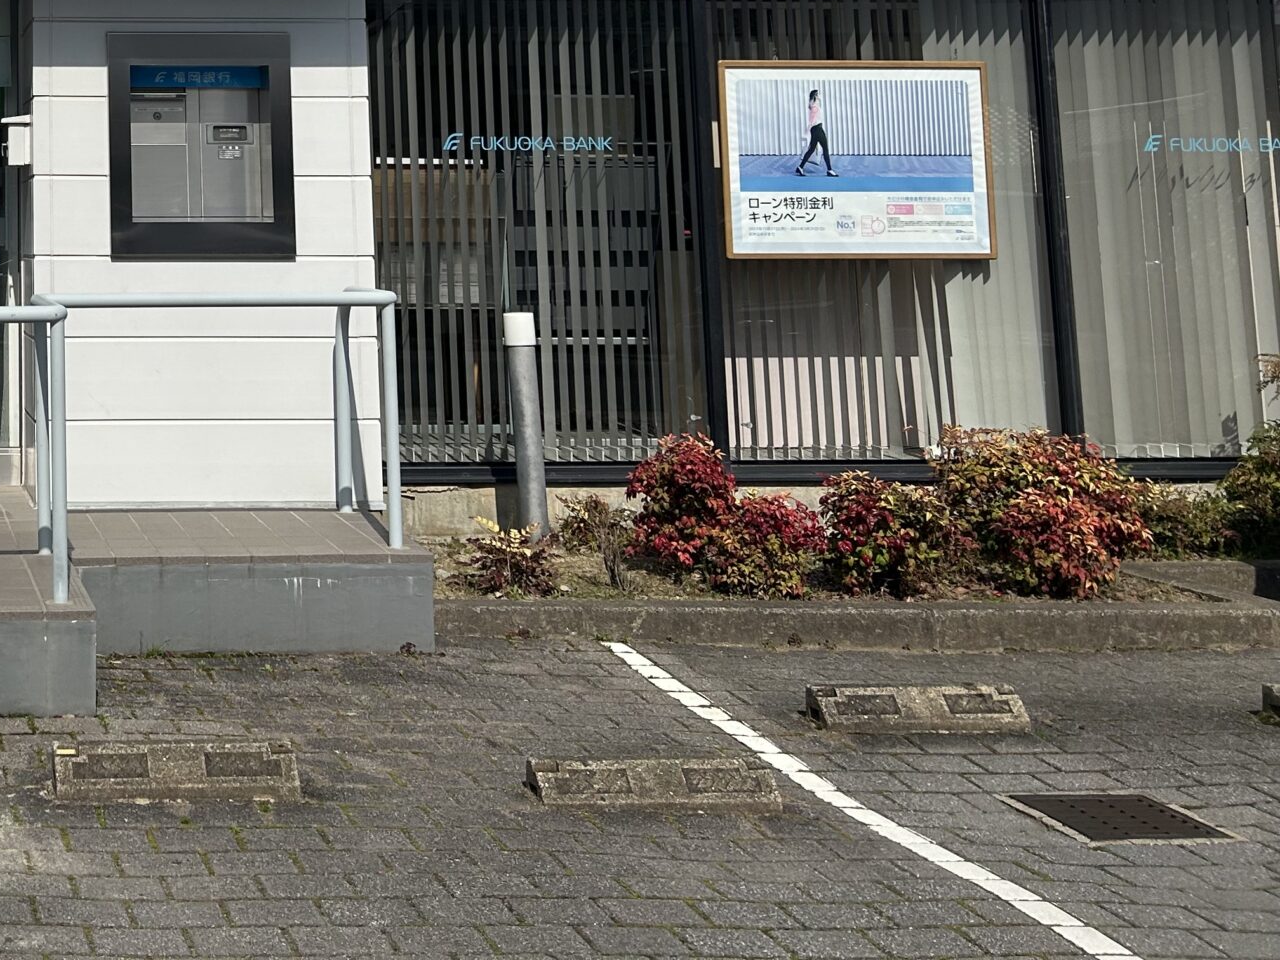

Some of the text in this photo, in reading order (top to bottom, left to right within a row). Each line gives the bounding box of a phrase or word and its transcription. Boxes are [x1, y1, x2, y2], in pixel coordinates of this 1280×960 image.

[173, 71, 231, 83] 福岡銀行
[470, 136, 613, 151] FUKUOKA BANK
[1170, 137, 1280, 152] FUKUOKA BA
[748, 196, 834, 210] ローン特別金利
[748, 211, 817, 223] キャンペーン
[836, 221, 856, 229] No.1
